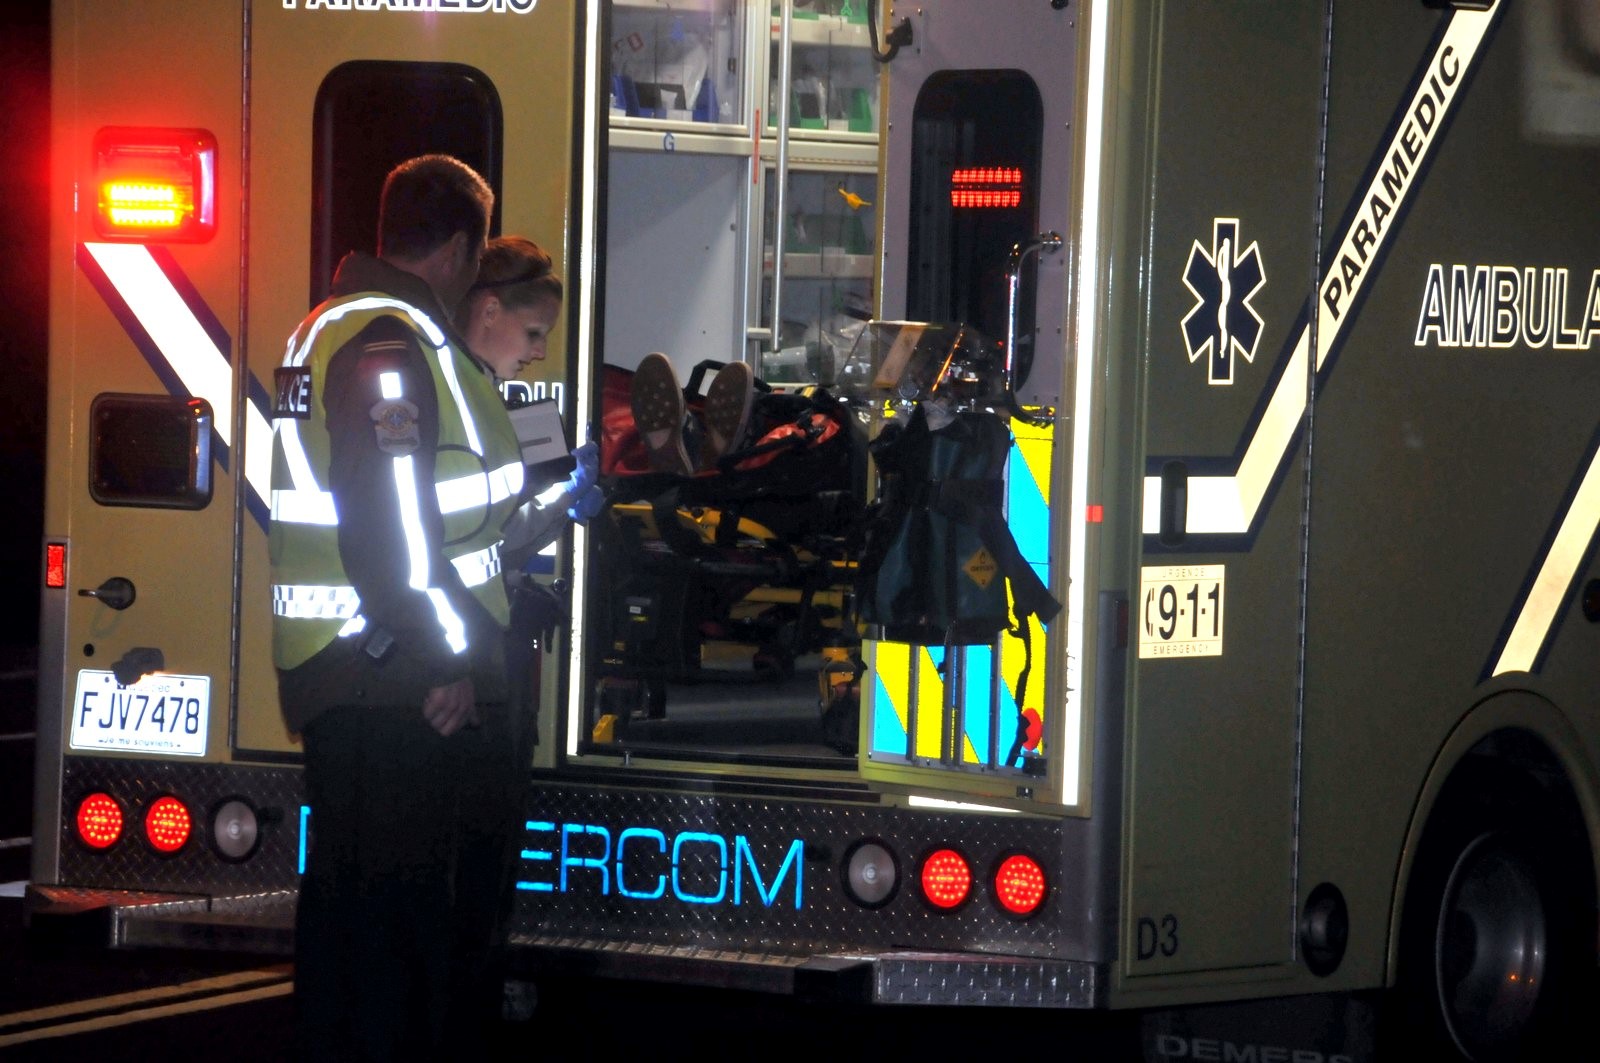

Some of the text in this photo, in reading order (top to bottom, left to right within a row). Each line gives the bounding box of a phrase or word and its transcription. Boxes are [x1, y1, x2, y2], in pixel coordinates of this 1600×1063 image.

[1322, 44, 1460, 321] PARAMEDIC
[1413, 263, 1600, 349] AMBULA
[80, 691, 200, 735] FJV7478
[1137, 913, 1179, 961] D3
